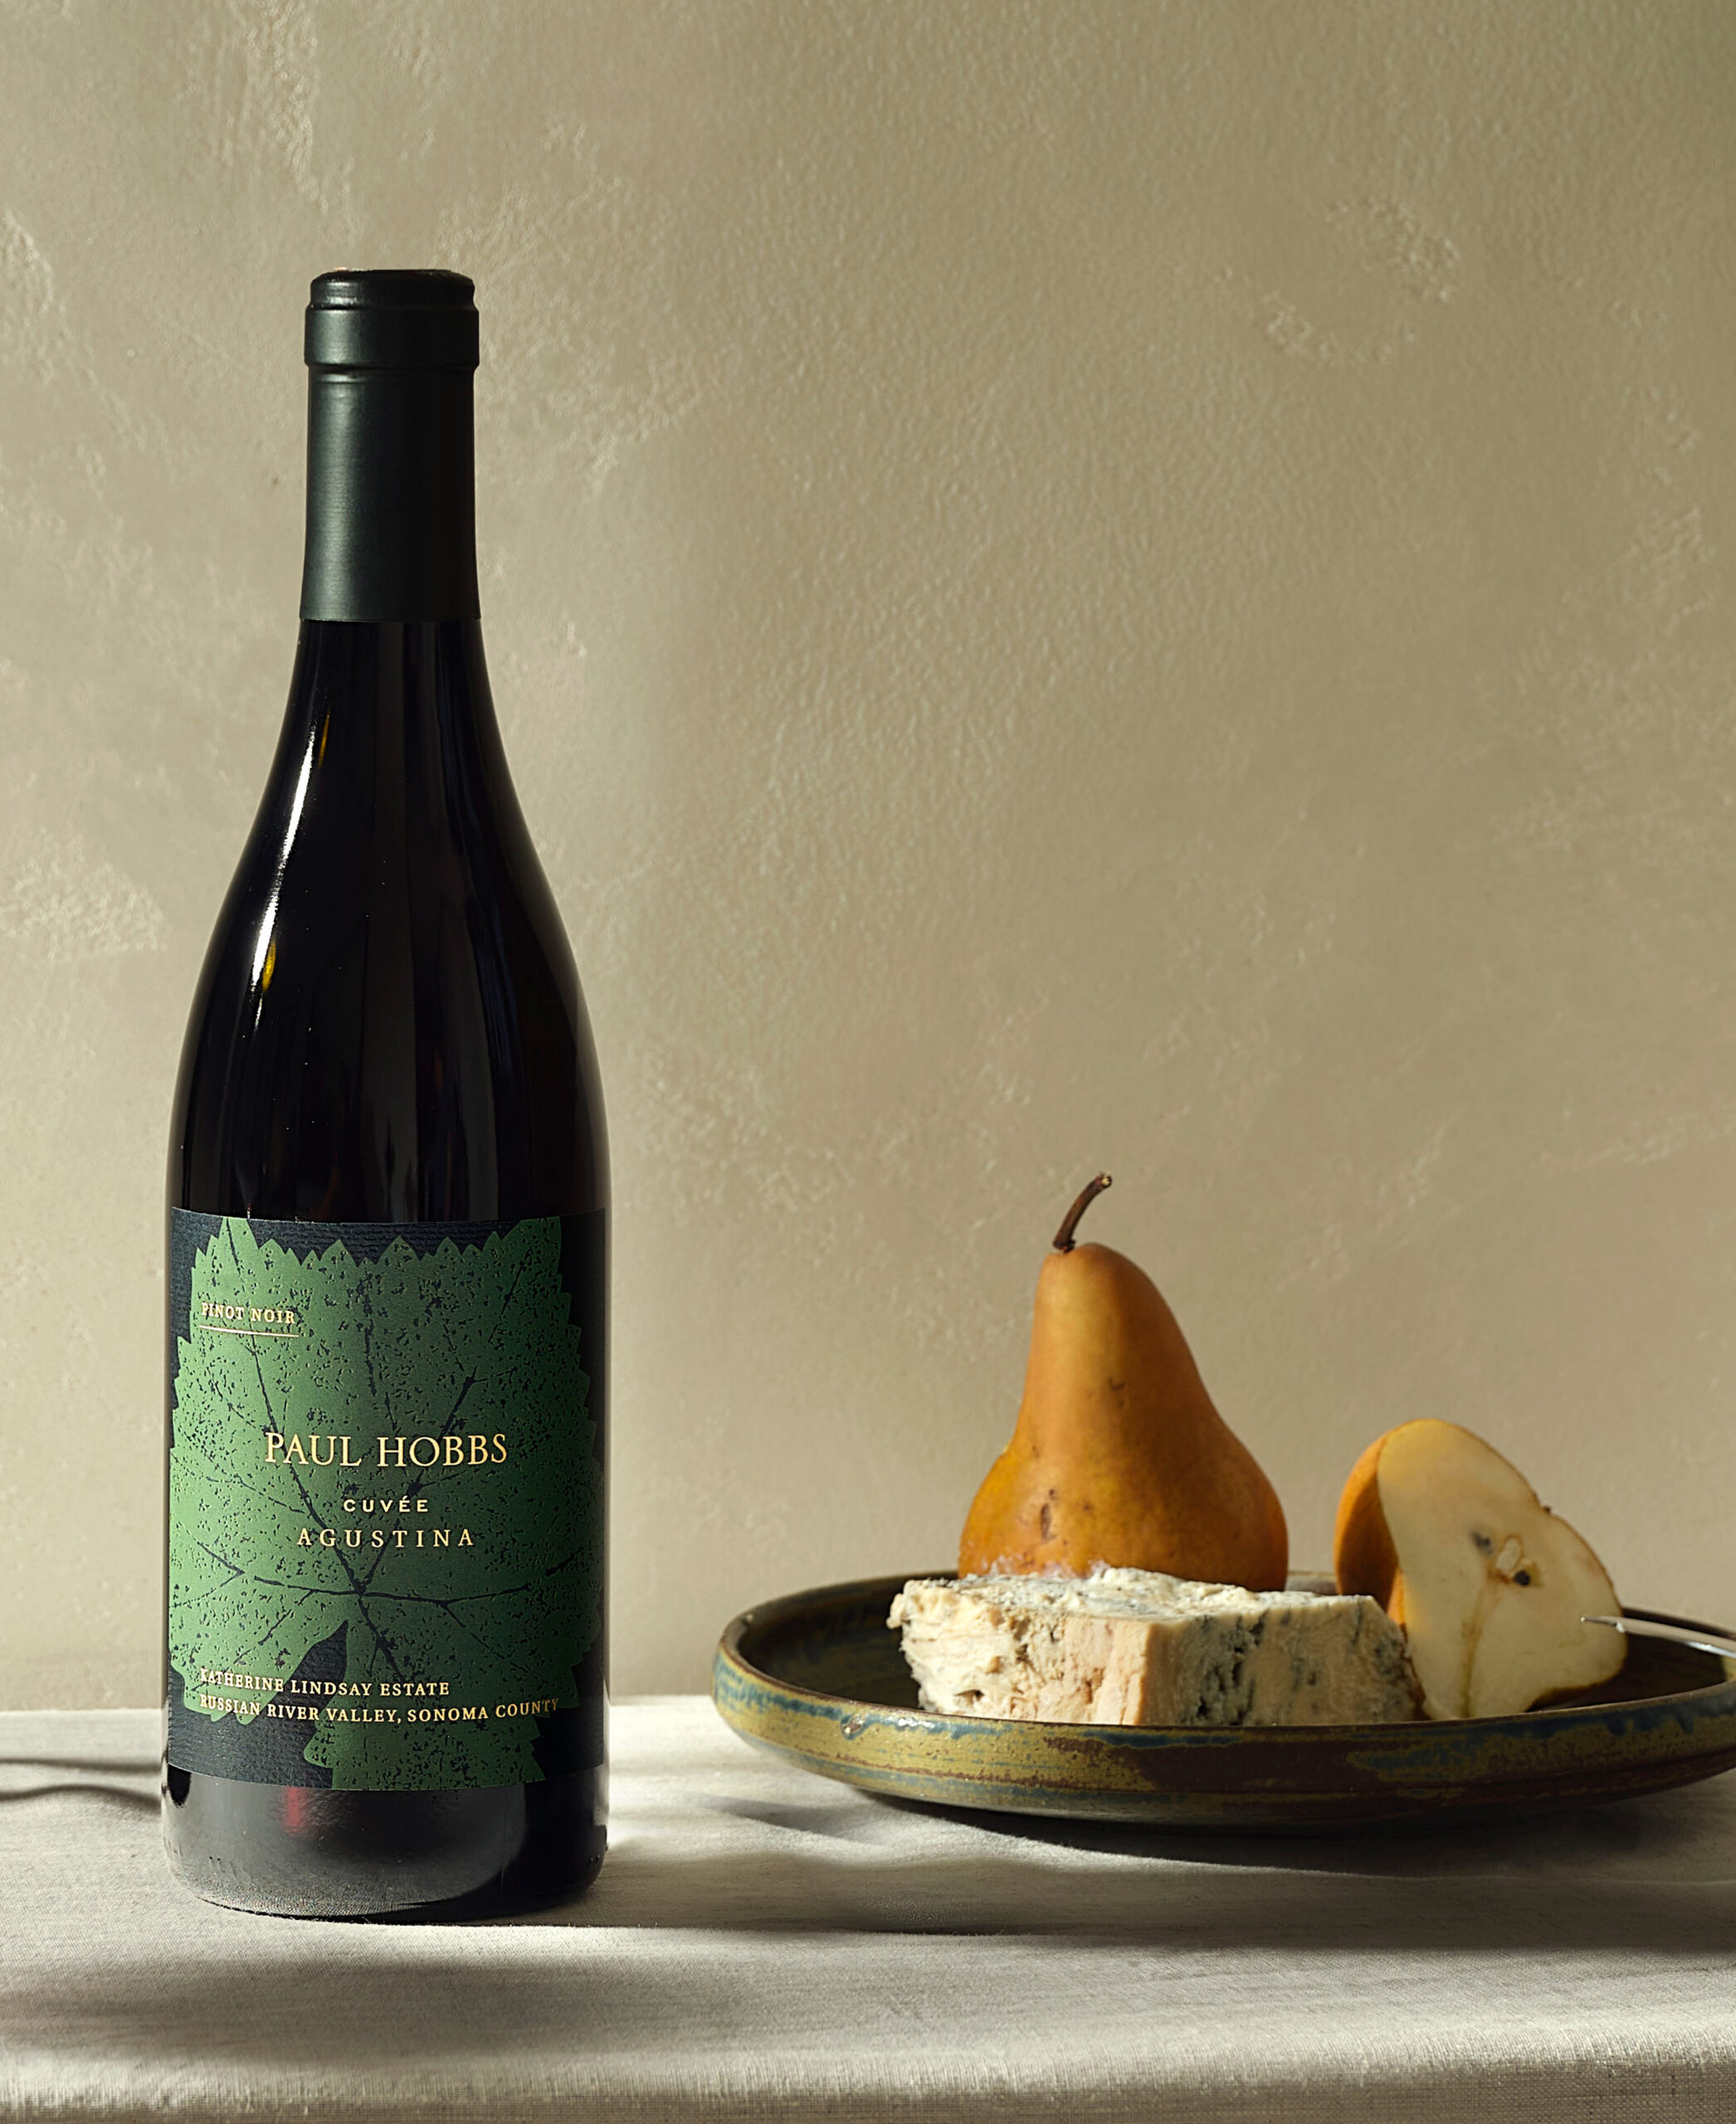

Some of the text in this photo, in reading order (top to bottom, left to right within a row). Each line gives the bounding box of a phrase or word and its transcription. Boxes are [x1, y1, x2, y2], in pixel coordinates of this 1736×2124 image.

[201, 1302, 295, 1324] PINOT NOIR
[265, 1431, 507, 1467] PAUL HOBBS
[343, 1496, 429, 1513] CUVÉE
[296, 1527, 474, 1548] AGUSTINA
[199, 1668, 450, 1697] KATHERINE LINDSAY ESTATE
[199, 1693, 559, 1724] RUSSIAN RIVER VALLEY, SONOMA COUNTY
